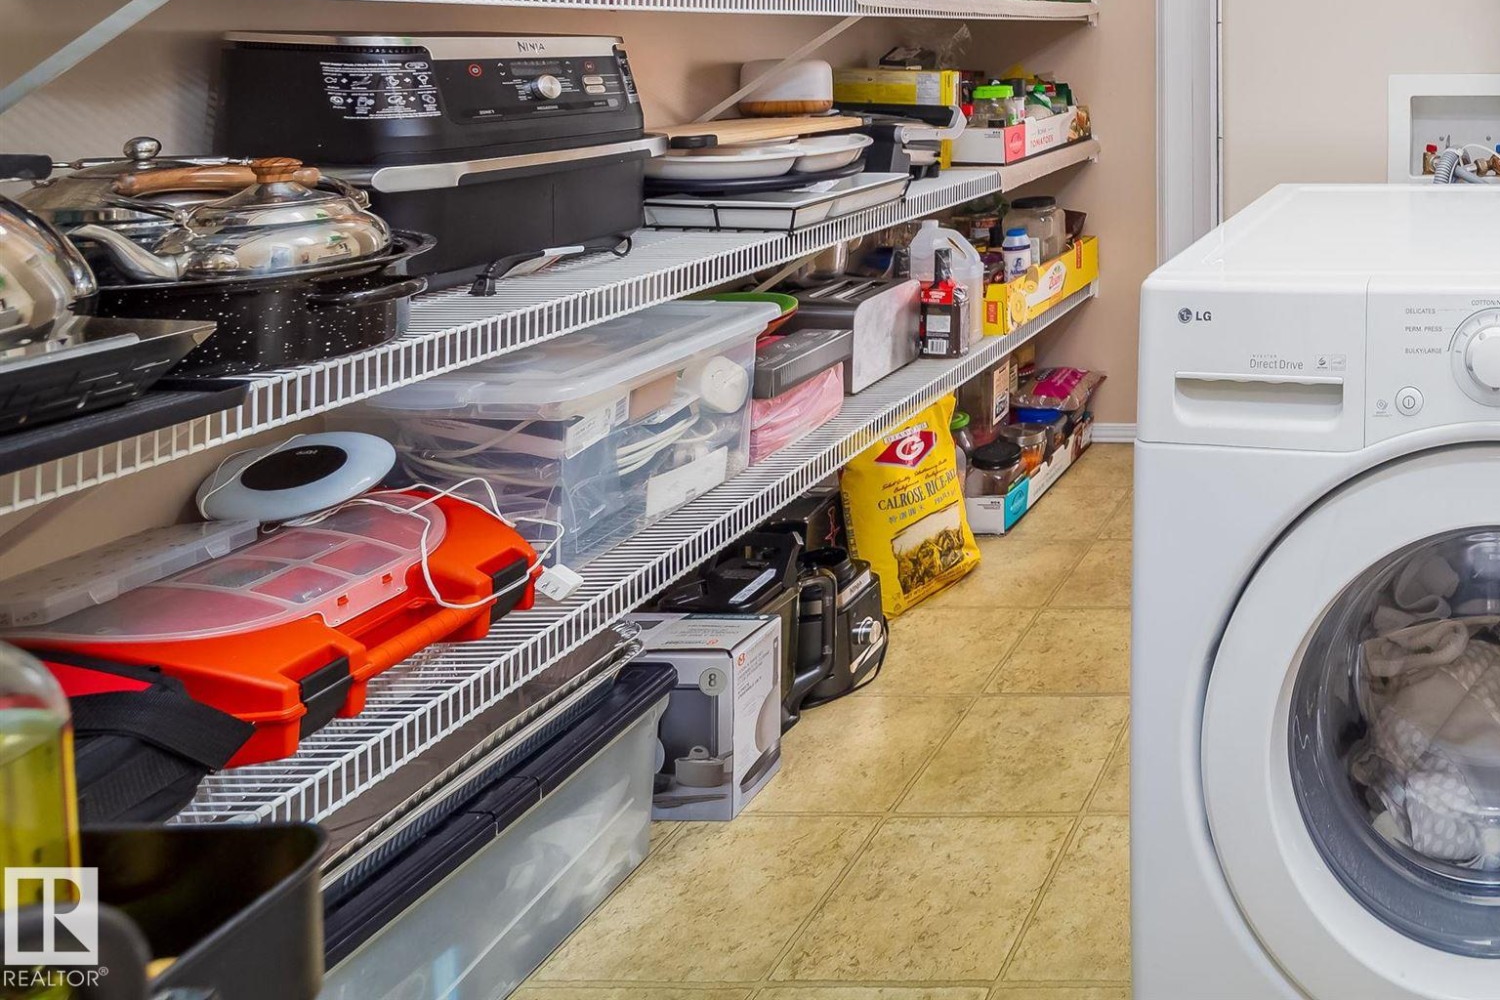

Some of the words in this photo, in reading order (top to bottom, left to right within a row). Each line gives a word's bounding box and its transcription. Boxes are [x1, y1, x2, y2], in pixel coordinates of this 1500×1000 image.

[517, 41, 545, 53] NINJA
[1195, 311, 1212, 322] LG
[1250, 358, 1277, 369] Direct
[1279, 359, 1304, 370] Drive
[895, 434, 925, 462] G
[878, 487, 926, 511] CALROSE
[708, 673, 717, 687] 8
